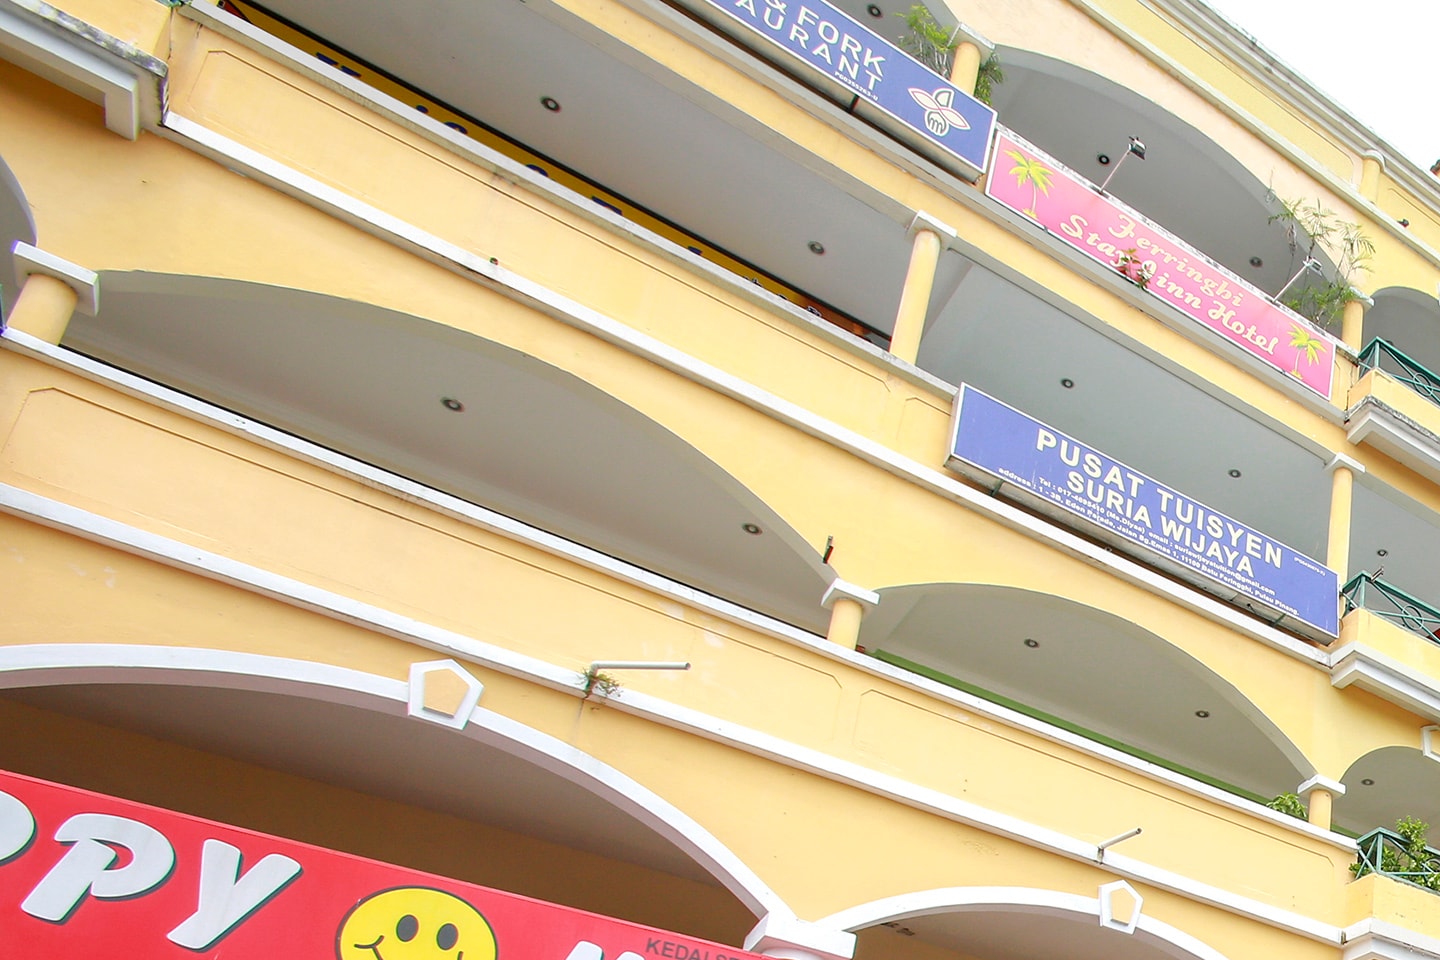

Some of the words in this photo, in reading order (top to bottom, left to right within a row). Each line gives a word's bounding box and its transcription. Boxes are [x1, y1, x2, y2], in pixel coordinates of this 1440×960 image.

[797, 5, 887, 77] FORK
[1060, 214, 1131, 267] Stay
[1208, 300, 1279, 355] Hotel
[1108, 214, 1245, 307] Ferringhi
[1036, 427, 1145, 498] PUSAT
[1156, 487, 1283, 569] TUISYEN
[1067, 470, 1152, 530] SURIA
[1160, 513, 1255, 578] WIJAYA
[1148, 531, 1169, 545] email
[1065, 499, 1086, 514] Eden
[1116, 525, 1138, 539] Jalan
[1254, 589, 1274, 604] Pulau
[0, 789, 303, 953] PY
